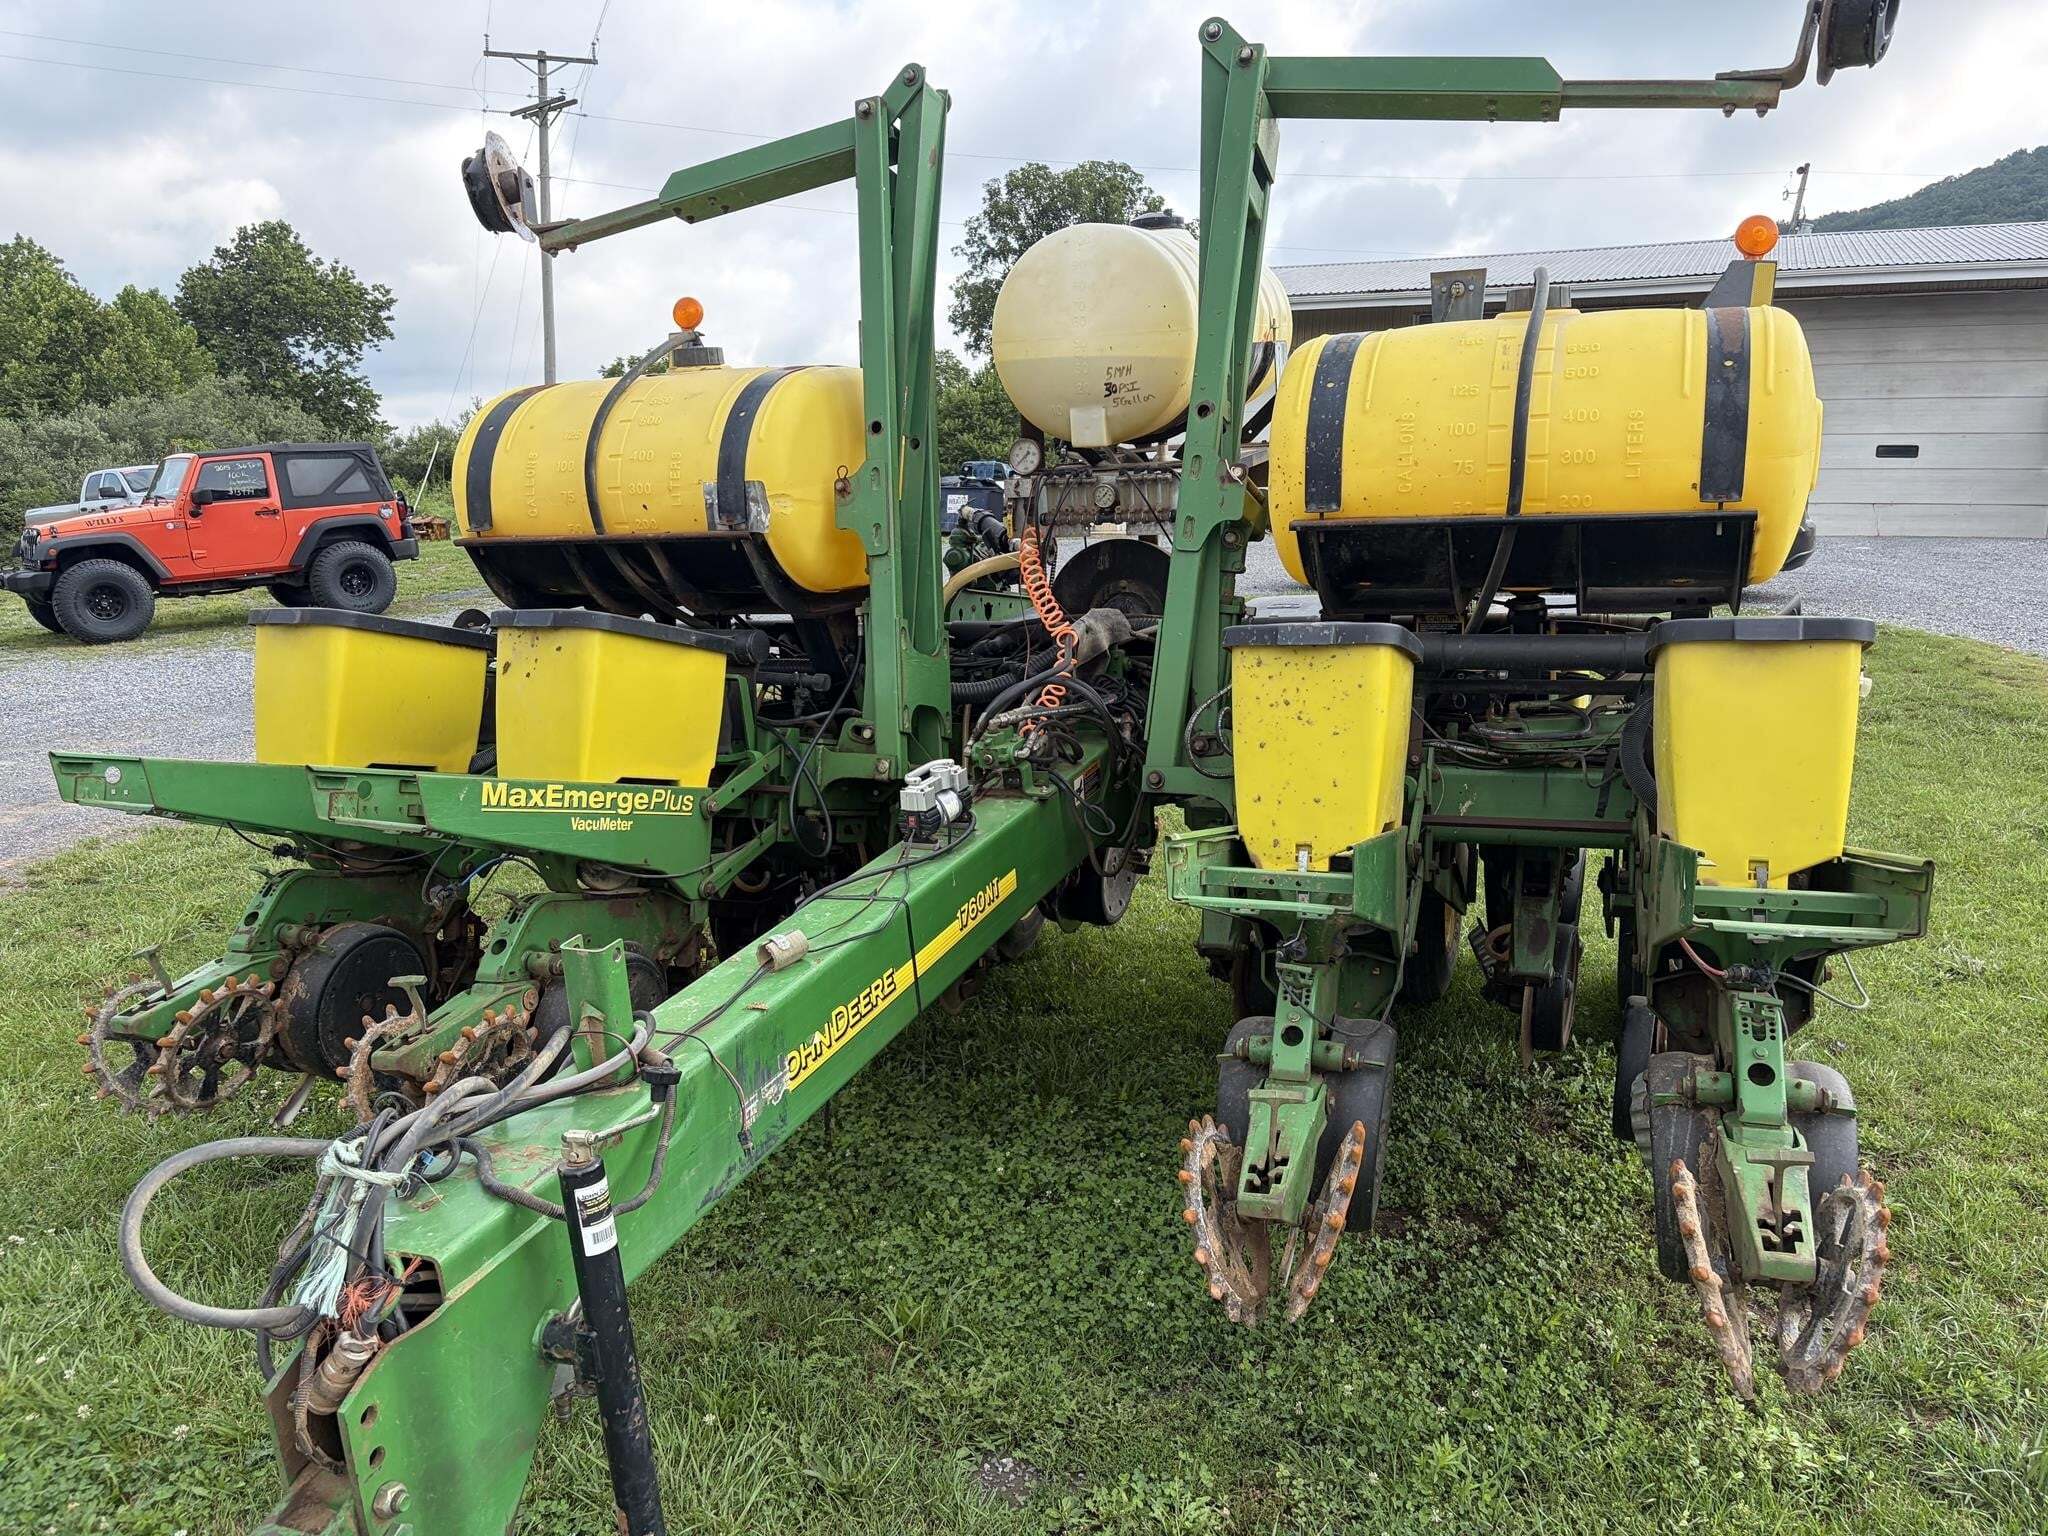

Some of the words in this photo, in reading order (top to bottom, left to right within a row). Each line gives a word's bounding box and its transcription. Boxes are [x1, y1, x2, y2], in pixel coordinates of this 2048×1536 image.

[1565, 366, 1600, 379] 500
[1451, 384, 1480, 397] 125
[1563, 408, 1600, 422] 400
[1449, 422, 1477, 436] 100
[1625, 409, 1645, 479] LITERS
[629, 449, 655, 462] 400
[1398, 411, 1416, 493] GALLONS
[1560, 448, 1597, 464] 300
[556, 460, 575, 473] 100
[1454, 459, 1475, 475] 75
[670, 449, 683, 507] LITERS
[628, 482, 652, 495] 300
[560, 490, 575, 504] 75
[1559, 494, 1593, 508] 200
[84, 515, 125, 528] WILLYS
[571, 817, 634, 832] VacuMeter
[956, 876, 1000, 931] 1760NT
[832, 967, 897, 1043] DEERE
